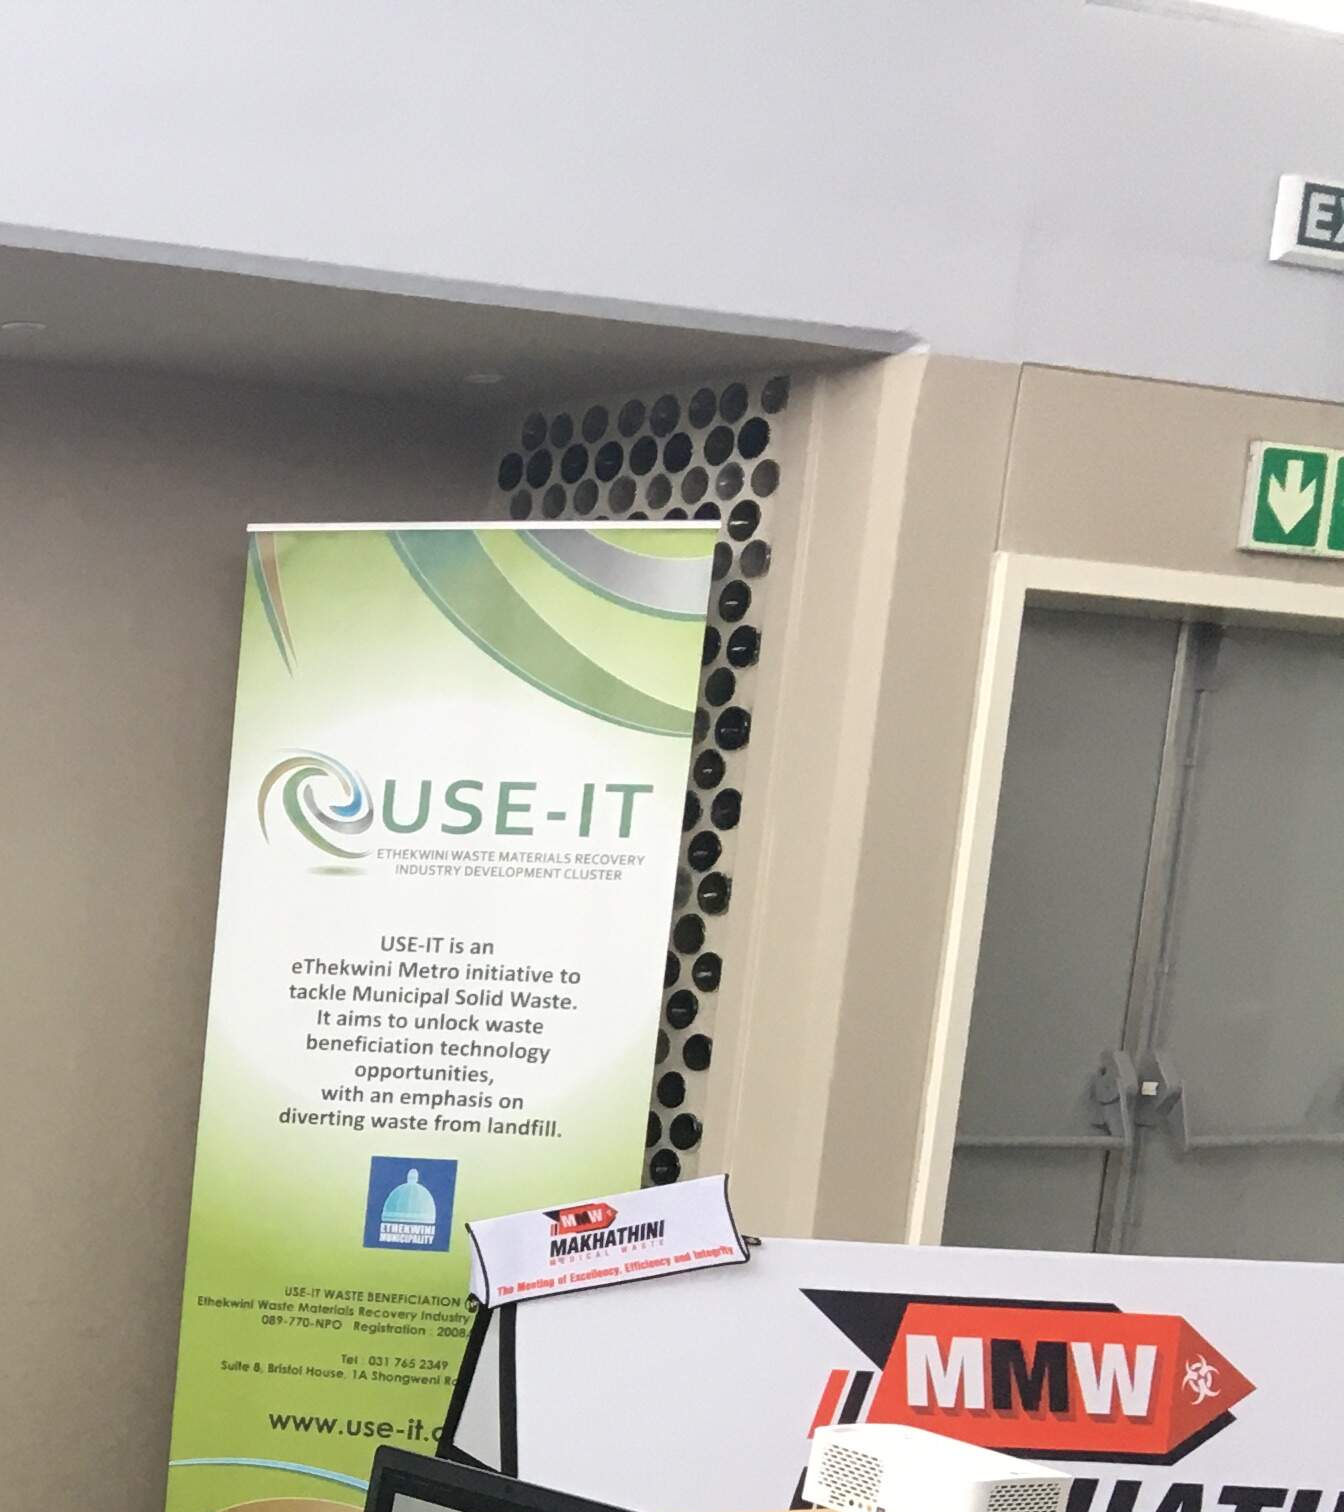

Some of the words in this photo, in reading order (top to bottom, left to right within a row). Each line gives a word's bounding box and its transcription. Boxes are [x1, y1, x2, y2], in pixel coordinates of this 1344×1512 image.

[382, 779, 654, 838] USE-IT
[377, 848, 448, 860] ETHEKWINI
[451, 850, 495, 862] WASTE
[498, 851, 571, 864] MATERIALS
[575, 853, 645, 865] RECOVERY
[395, 864, 461, 876] INDUSTRY
[464, 865, 561, 878] DEVELOPMENT
[564, 868, 622, 880] CLUSTER
[381, 936, 444, 953] USE-IT
[449, 937, 464, 954] is
[470, 942, 494, 955] an
[292, 958, 392, 977] eThekwini
[399, 962, 459, 980] Metro
[466, 964, 553, 983] initiative
[560, 969, 581, 984] to
[289, 984, 346, 1001] tackle
[353, 986, 449, 1008] Municipal
[455, 989, 503, 1006] Solid
[510, 991, 577, 1010] Waste.
[317, 1010, 331, 1025] It
[336, 1010, 381, 1028] aims
[388, 1014, 408, 1029] to
[414, 1013, 479, 1031] unlock
[486, 1019, 544, 1034] waste
[306, 1034, 433, 1055] beneficiation
[440, 1040, 550, 1064] technology
[355, 1065, 494, 1086] opportunities,
[321, 1086, 364, 1102] with
[370, 1091, 394, 1103] an
[400, 1090, 492, 1109] emphasis
[499, 1097, 523, 1110] on
[279, 1107, 365, 1131] diverting
[371, 1116, 428, 1131] waste
[434, 1114, 481, 1133] from
[488, 1117, 561, 1137] landfill.
[561, 1209, 603, 1228] MMW
[550, 1220, 664, 1258] MAKHATHINI
[498, 1286, 514, 1296] The
[625, 1257, 671, 1274] Efficiency
[674, 1251, 691, 1264] and
[285, 1286, 320, 1298] USE-IT
[324, 1290, 364, 1302] WASTE
[367, 1292, 461, 1307] BENEFICIATION
[353, 1321, 426, 1336] Registration
[221, 1360, 250, 1373] Suite
[268, 1363, 303, 1376] Bristol
[372, 1371, 440, 1386] Shongweni
[368, 1356, 390, 1367] 031
[419, 1359, 448, 1370] 2349
[906, 1334, 1157, 1416] MMW
[269, 1414, 444, 1442] www.use-it.c
